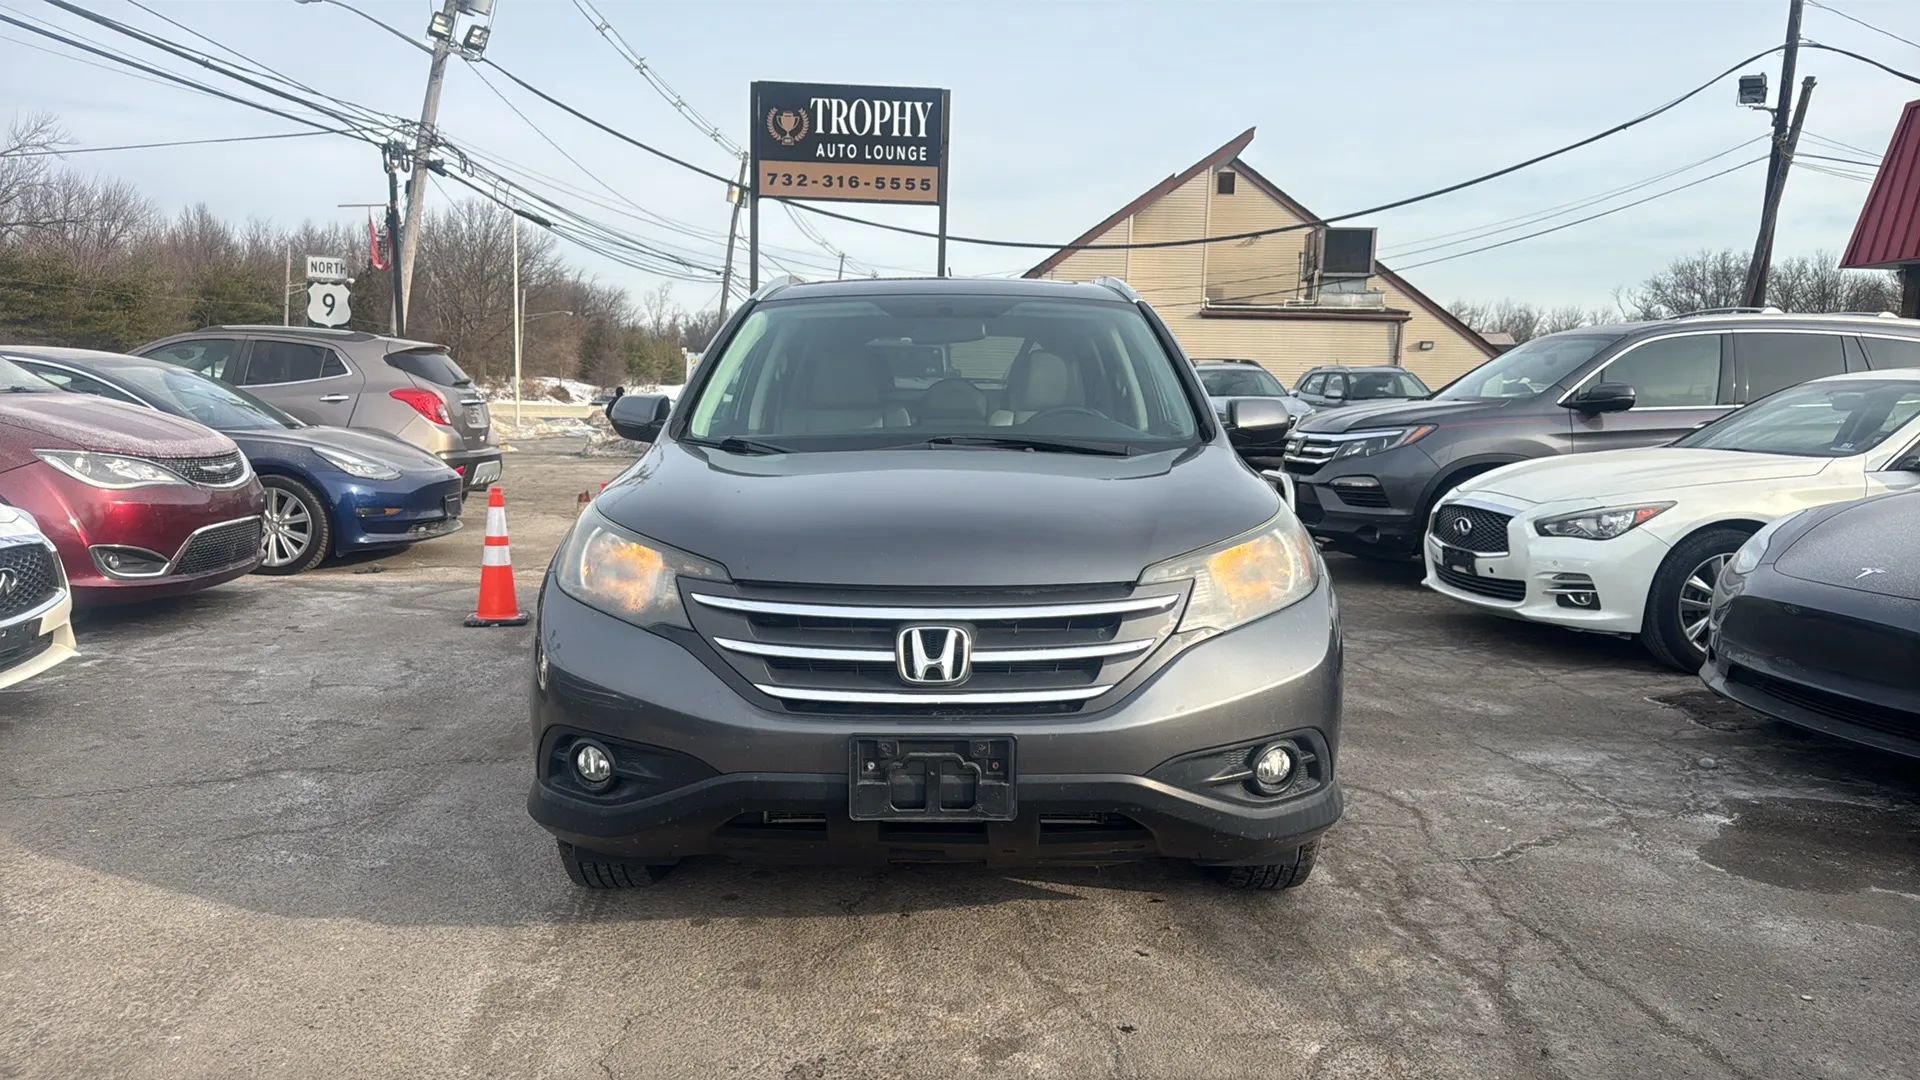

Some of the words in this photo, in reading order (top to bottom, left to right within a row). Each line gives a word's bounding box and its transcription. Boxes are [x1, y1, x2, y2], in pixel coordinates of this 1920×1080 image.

[810, 98, 934, 138] TROPHY
[816, 143, 857, 159] AUTO
[865, 144, 927, 161] LOUNGE
[767, 172, 932, 191] 732-316-5555
[310, 261, 347, 274] NORTH
[322, 293, 336, 316] 9
